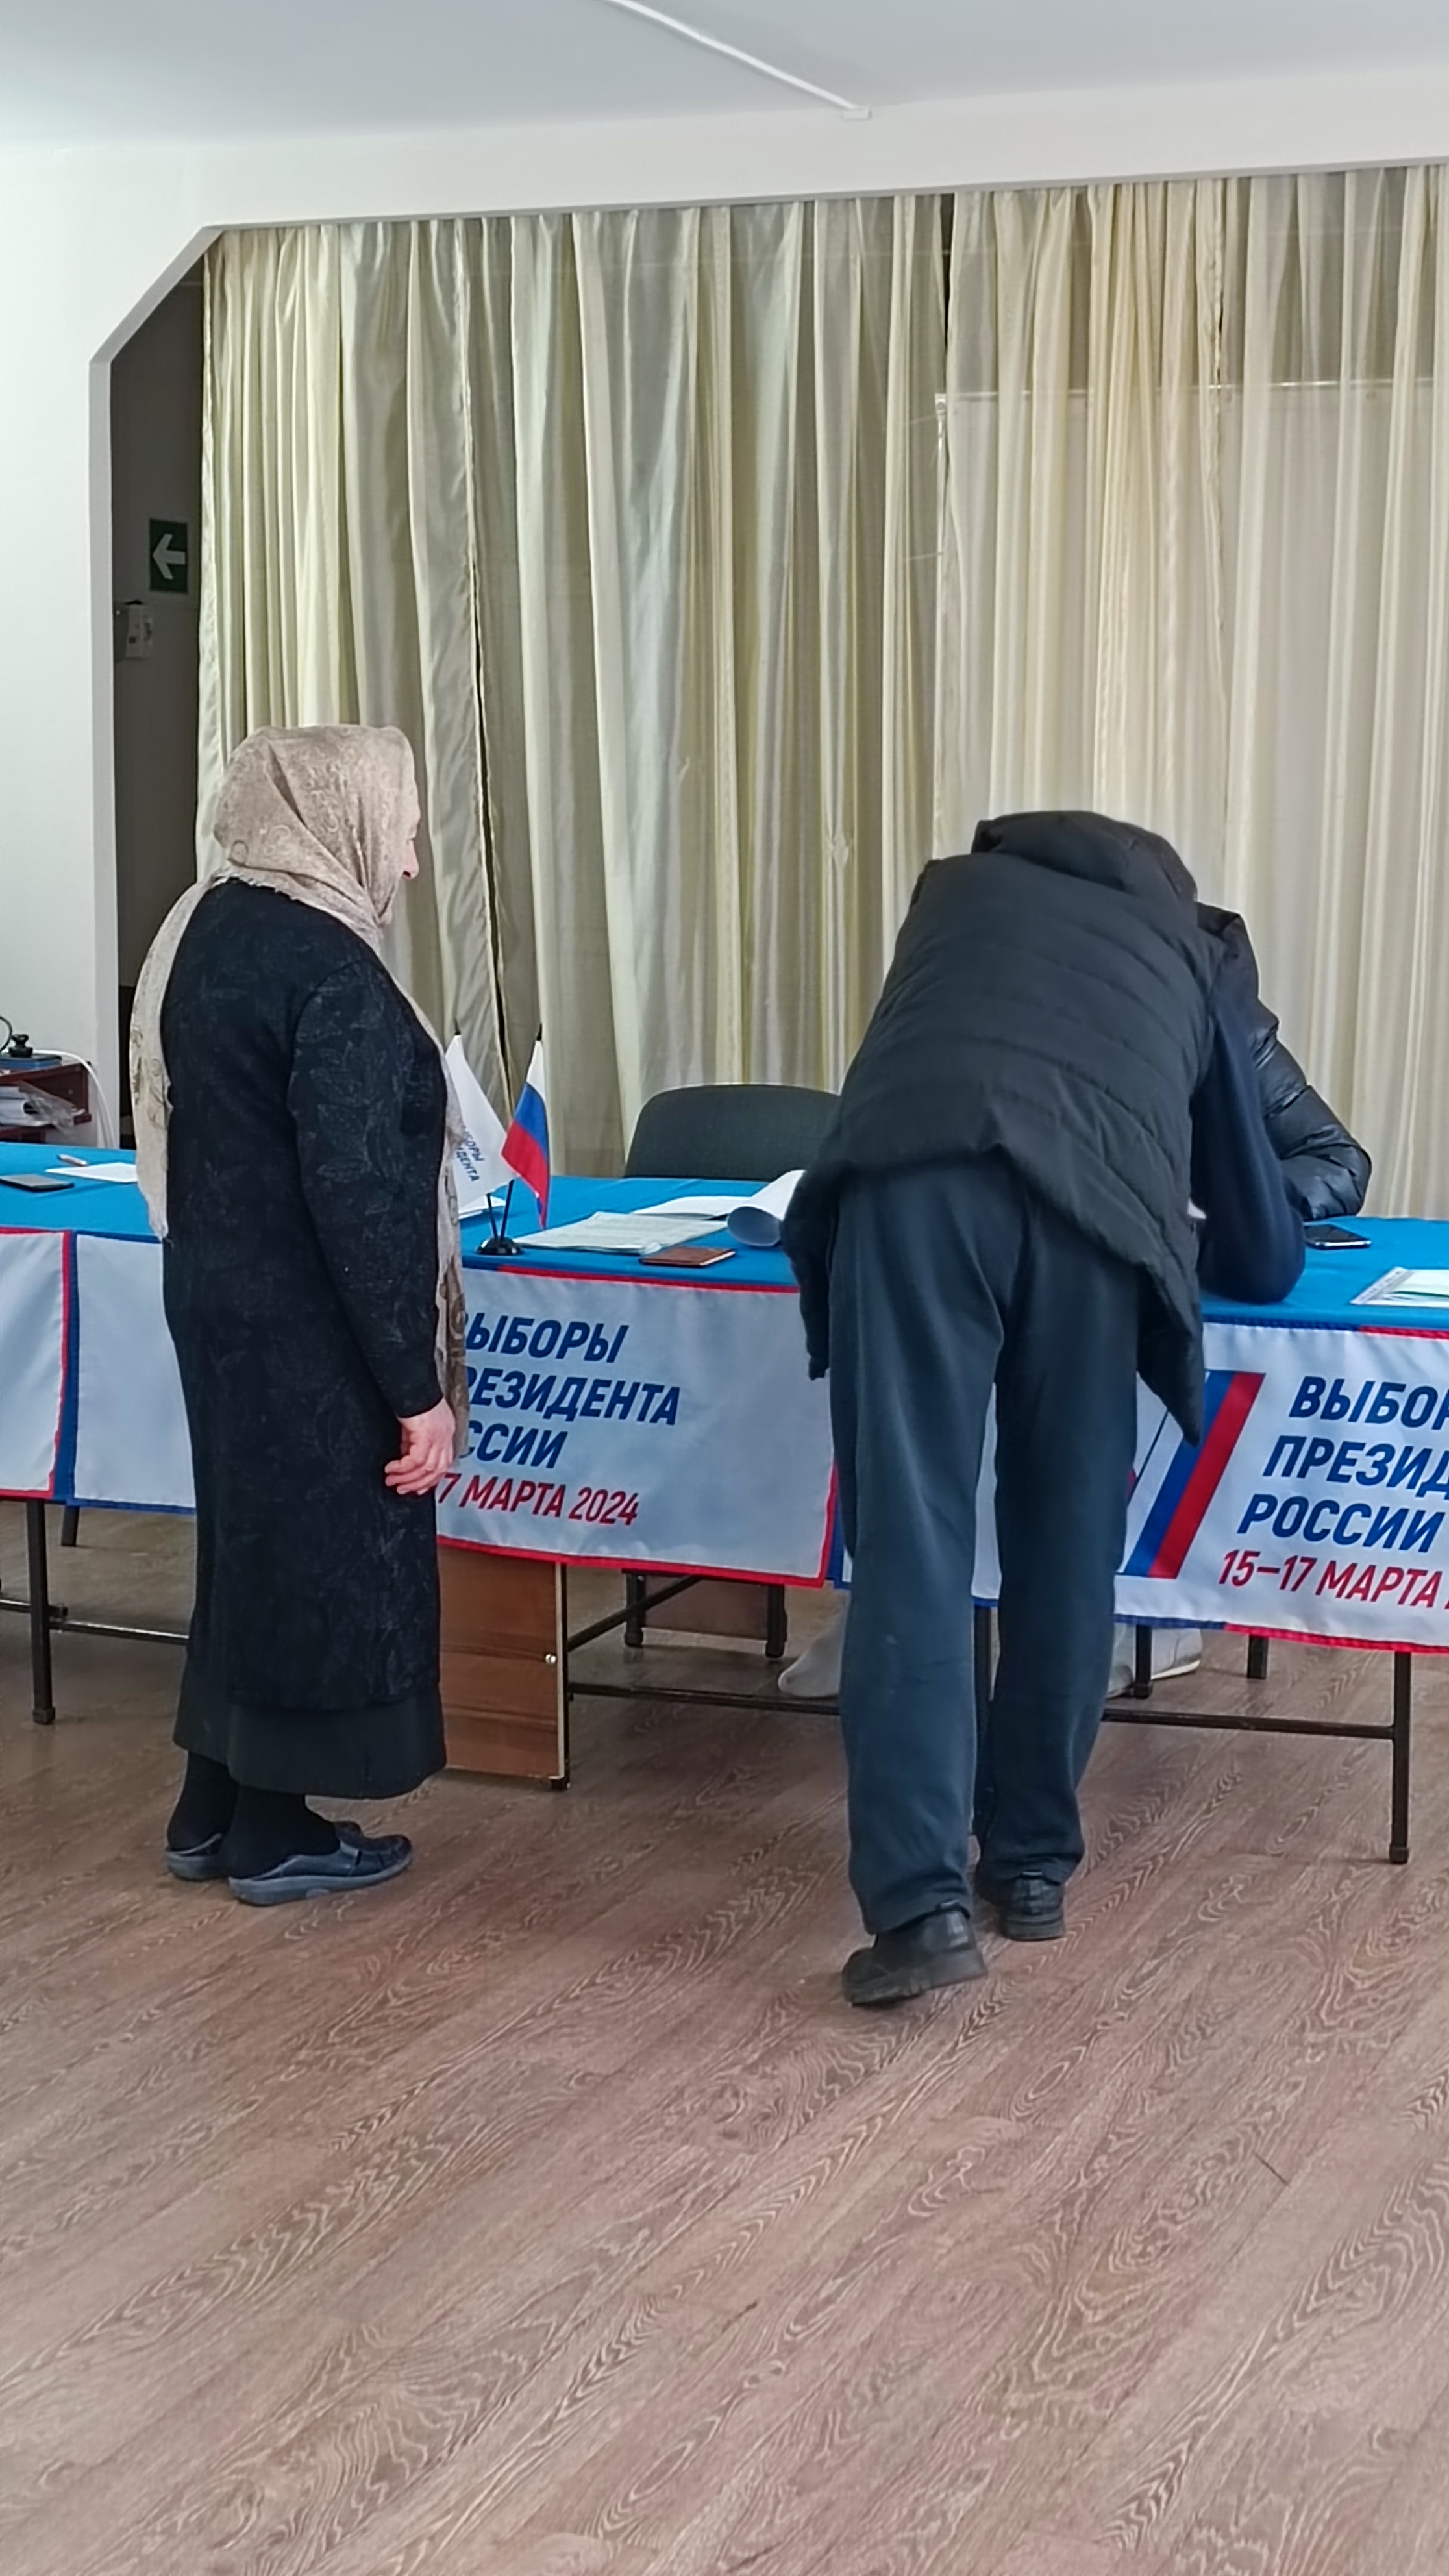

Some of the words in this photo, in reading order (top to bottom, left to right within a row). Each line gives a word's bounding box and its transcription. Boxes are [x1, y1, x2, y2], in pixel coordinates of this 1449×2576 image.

[464, 1312, 629, 1363] ЫБОРЫ
[466, 1365, 680, 1426] ЕЗИДЕНТА
[460, 1420, 569, 1469] ССИИ
[458, 1474, 567, 1518] МАРТА
[567, 1486, 639, 1526] 2024
[1236, 1493, 1446, 1554] РОССИИ
[1315, 1559, 1443, 1609] МАРТА
